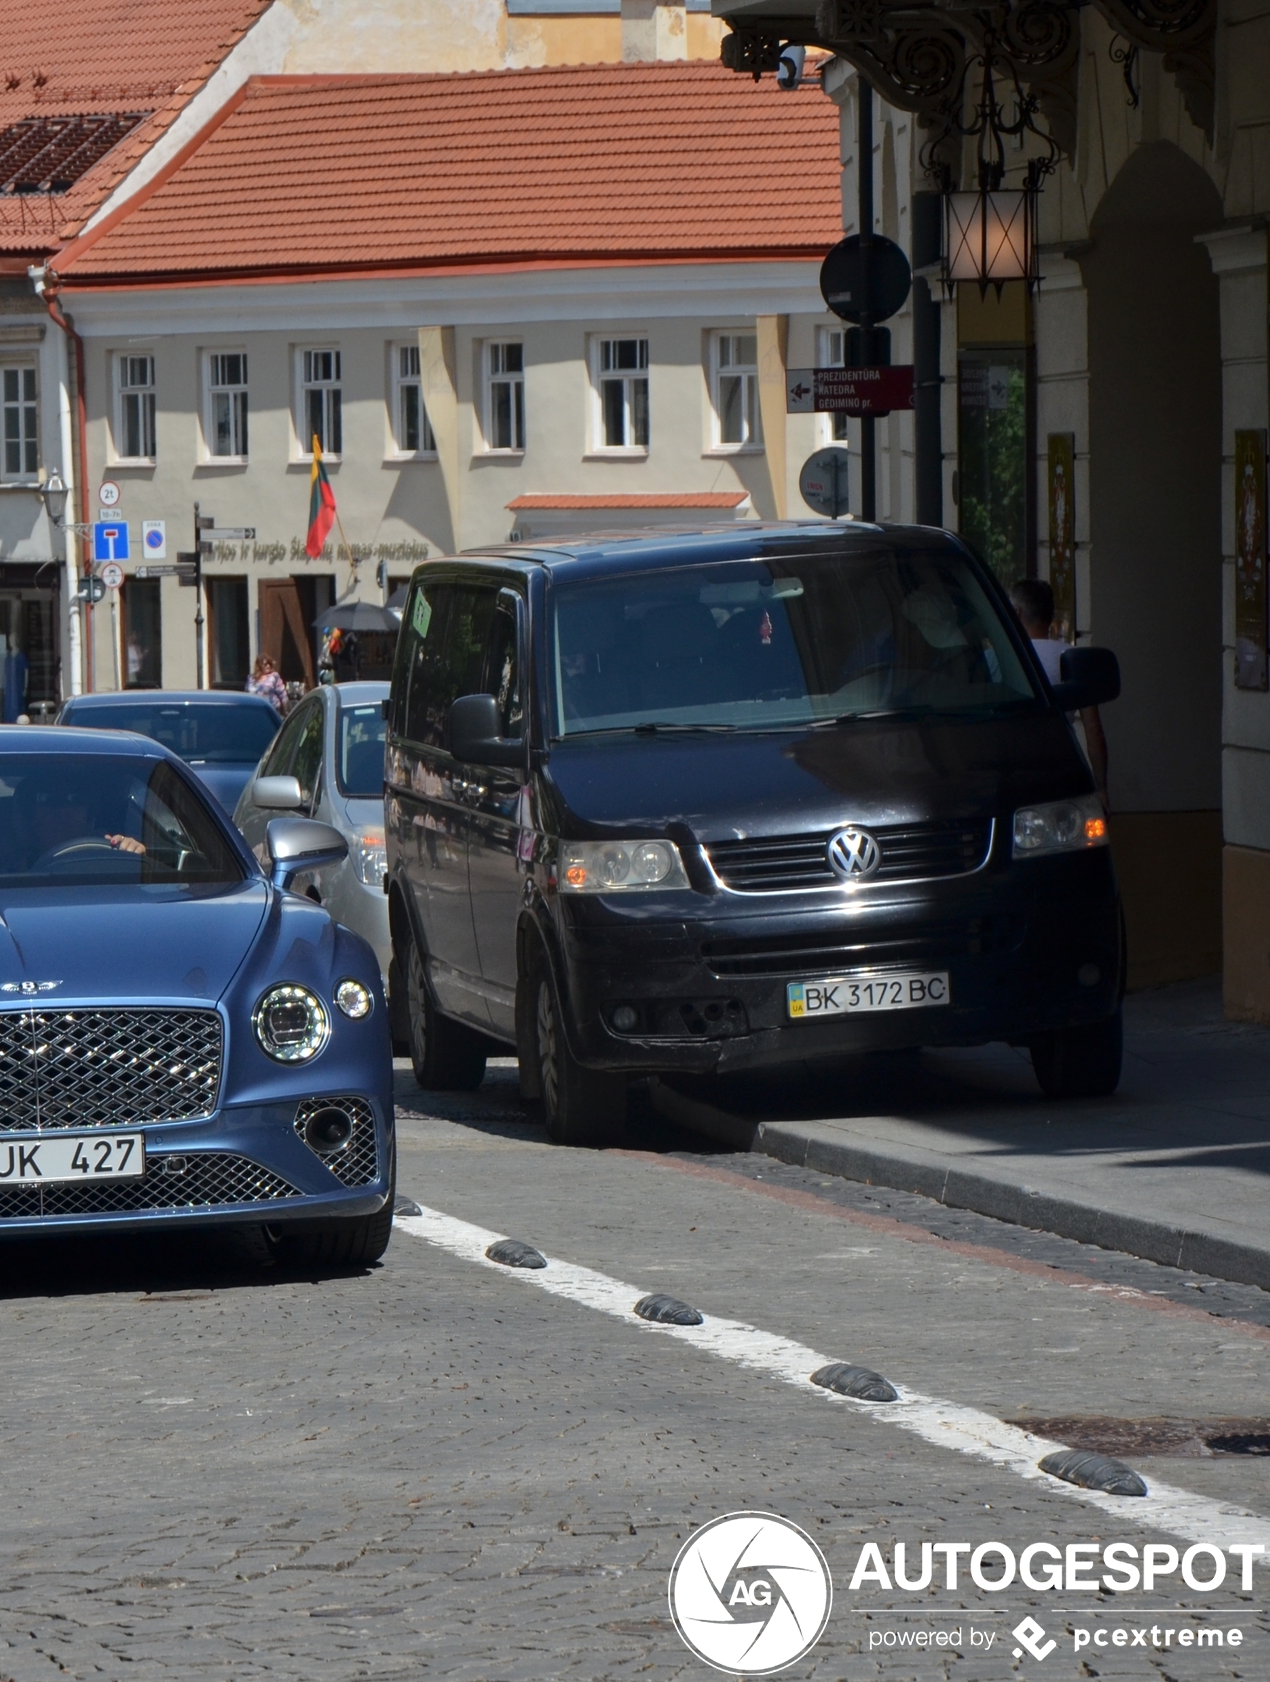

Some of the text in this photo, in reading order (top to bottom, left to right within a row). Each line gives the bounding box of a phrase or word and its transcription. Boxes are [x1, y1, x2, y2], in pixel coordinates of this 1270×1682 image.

[818, 384, 856, 395] KATEDRA
[104, 489, 114, 499] 2t
[805, 986, 841, 1011] BK
[848, 981, 903, 1007] 3172
[909, 977, 945, 1002] BC
[71, 1138, 136, 1173] 427
